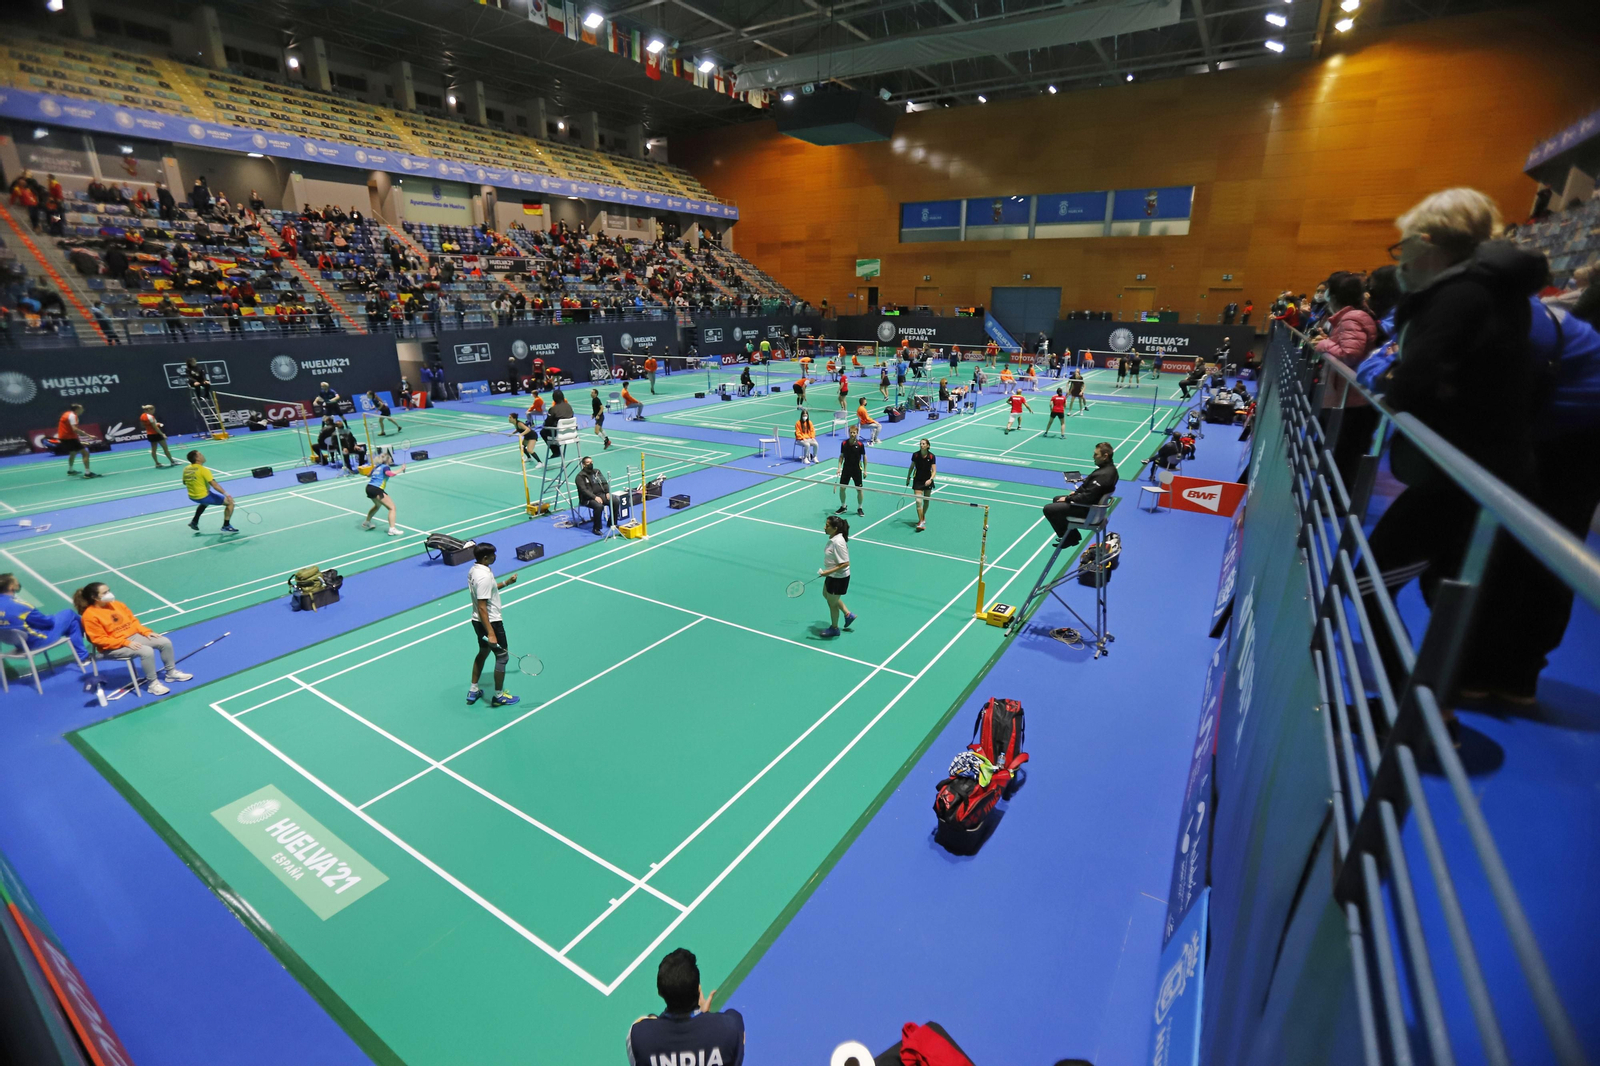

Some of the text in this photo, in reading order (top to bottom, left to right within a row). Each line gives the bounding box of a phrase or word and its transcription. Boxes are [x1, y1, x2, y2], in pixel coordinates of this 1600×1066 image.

[410, 199, 442, 208] Ayuntamiento
[898, 327, 937, 336] HUELVA'21
[903, 334, 929, 342] ESPAÑA
[1137, 335, 1189, 346] HUELVA'21
[530, 342, 560, 351] HUELVA'21
[301, 357, 350, 370] HUELVA'21
[1163, 363, 1192, 371] TOYOTA
[311, 366, 343, 376] ESPAÑA
[42, 374, 120, 390] HUELVA'21
[60, 385, 110, 397] ESPAÑA
[1187, 490, 1218, 501] BWF
[621, 497, 628, 506] 3
[264, 816, 362, 895] HUELVA'21
[270, 851, 305, 882] ESPAÑA
[650, 1047, 725, 1066] INDIA
